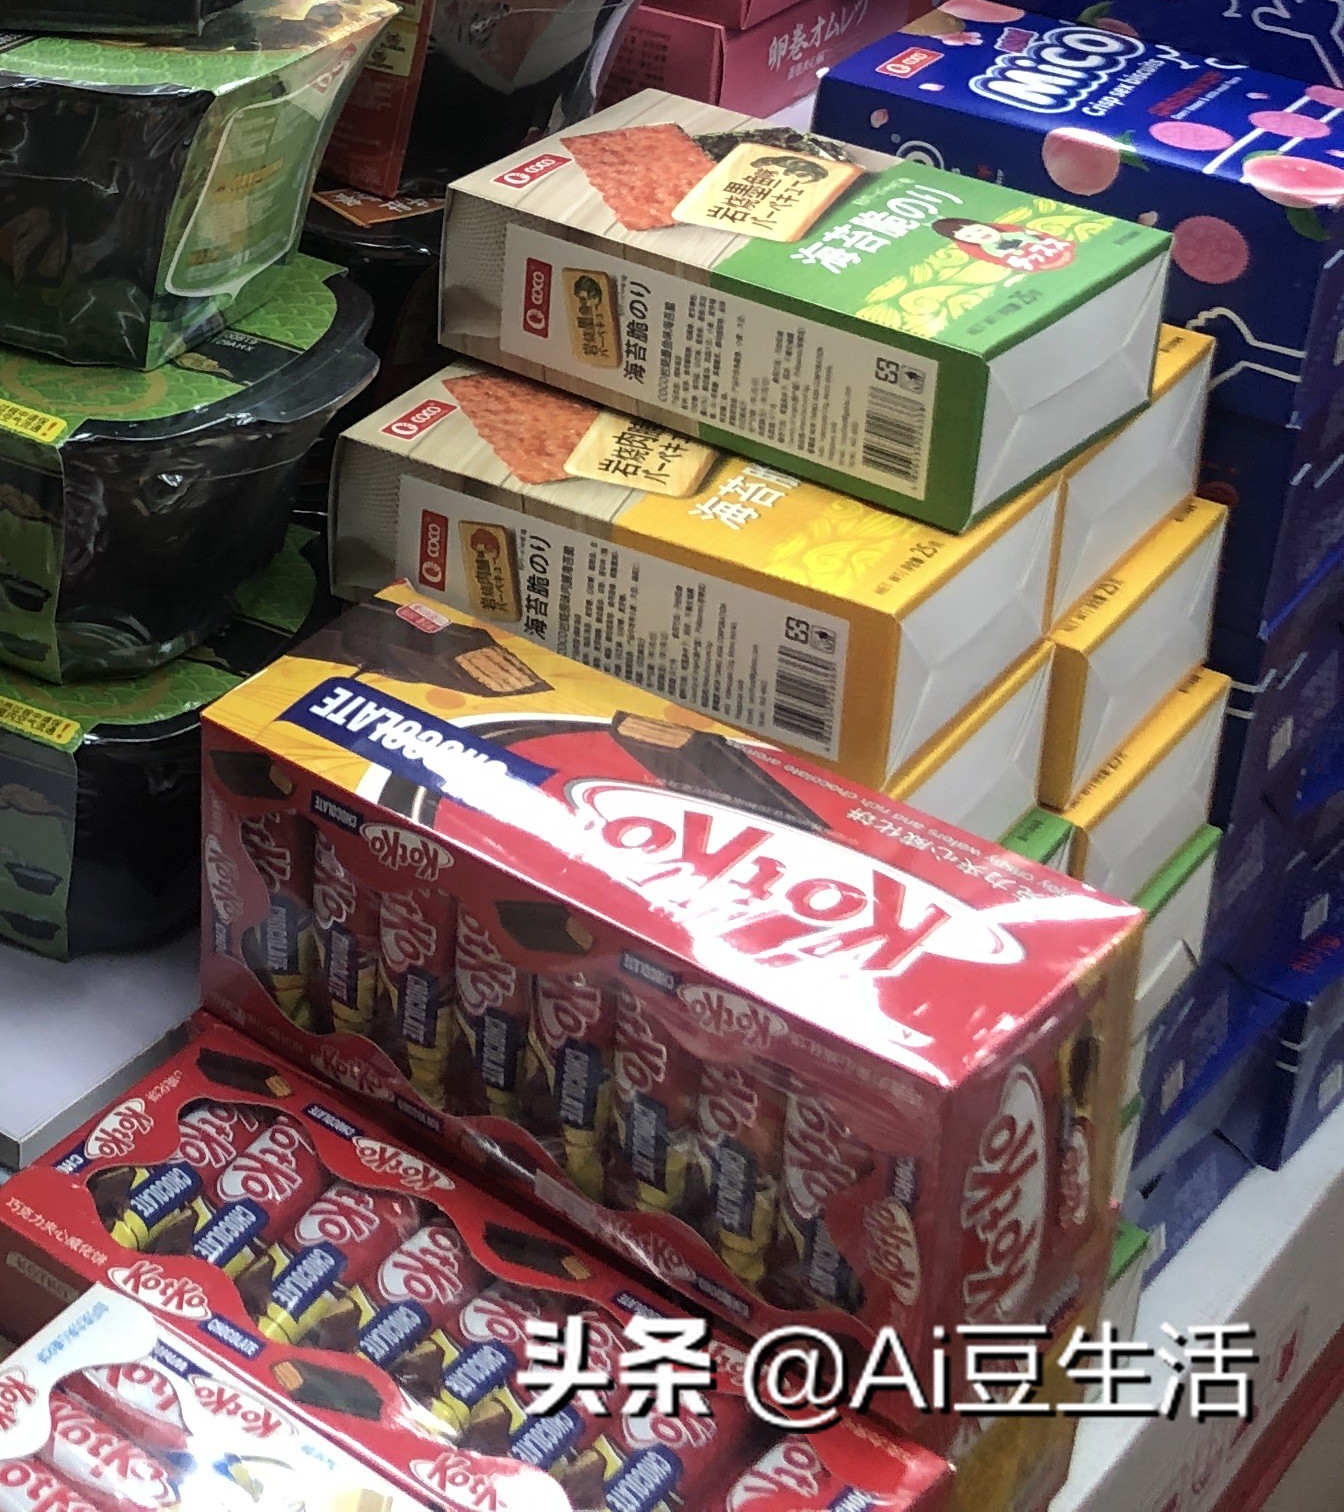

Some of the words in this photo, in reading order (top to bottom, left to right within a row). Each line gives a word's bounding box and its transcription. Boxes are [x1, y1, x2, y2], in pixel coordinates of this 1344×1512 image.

[1083, 90, 1117, 118] Crisp
[789, 184, 965, 274] 海苔脆のり
[623, 280, 652, 385] 海苔脆のり
[523, 532, 553, 641] 海苔脆のり
